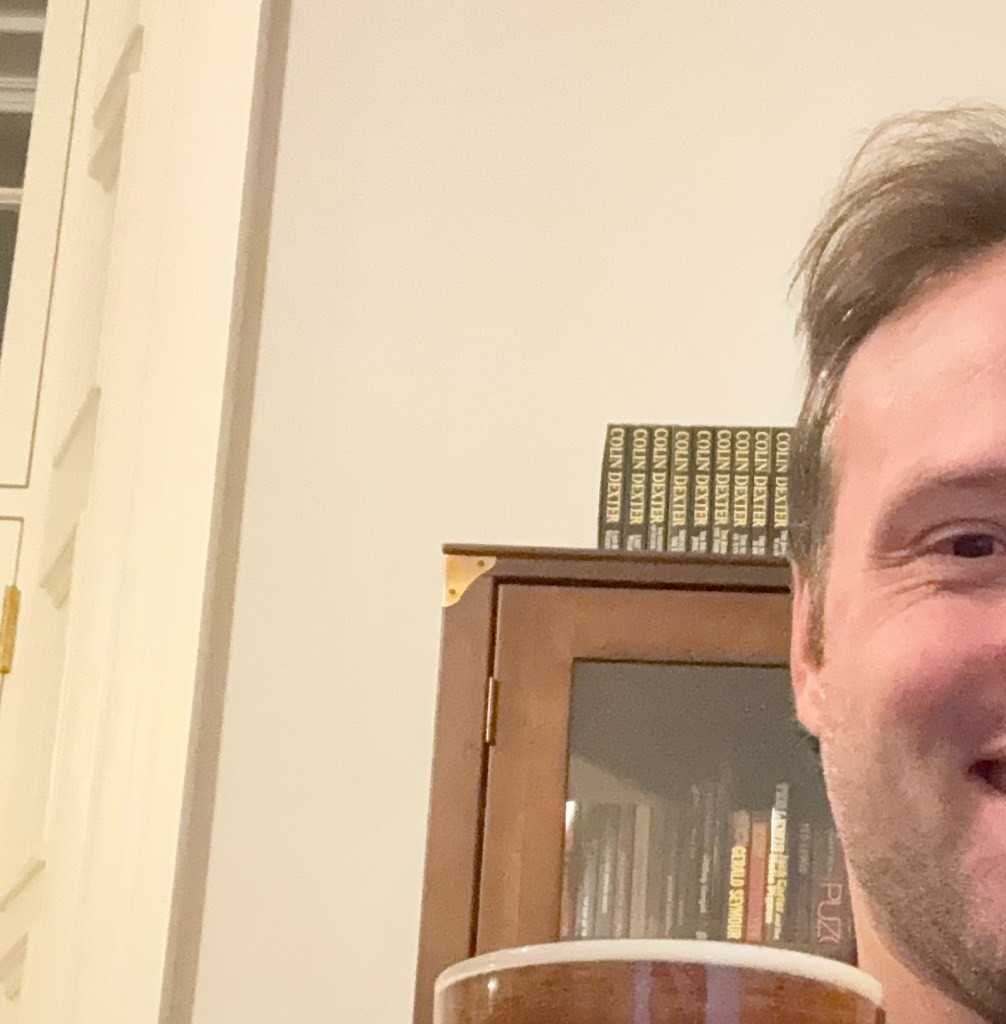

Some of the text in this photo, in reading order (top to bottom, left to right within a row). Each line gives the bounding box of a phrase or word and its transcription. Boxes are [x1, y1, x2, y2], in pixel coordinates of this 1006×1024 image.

[609, 428, 625, 469] COLIN
[632, 428, 648, 469] COLIN
[652, 428, 668, 469] COLIN
[674, 431, 690, 472] COLIN
[695, 430, 711, 472] COLIN
[716, 429, 732, 471] COLIN
[735, 430, 750, 472] COLIN
[754, 431, 769, 473] COLIN
[776, 432, 790, 473] COLIN
[606, 472, 623, 523] DEXTER
[629, 473, 646, 524] DEXTER
[650, 472, 667, 524] DEXTER
[672, 475, 689, 526] DEXTER
[694, 474, 710, 526] DEXTER
[714, 473, 730, 525] DEXTER
[733, 475, 749, 526] DEXTER
[752, 475, 768, 527] DEXTER
[774, 476, 789, 527] DEXTER
[727, 846, 747, 940] GERALD SEYMOUR
